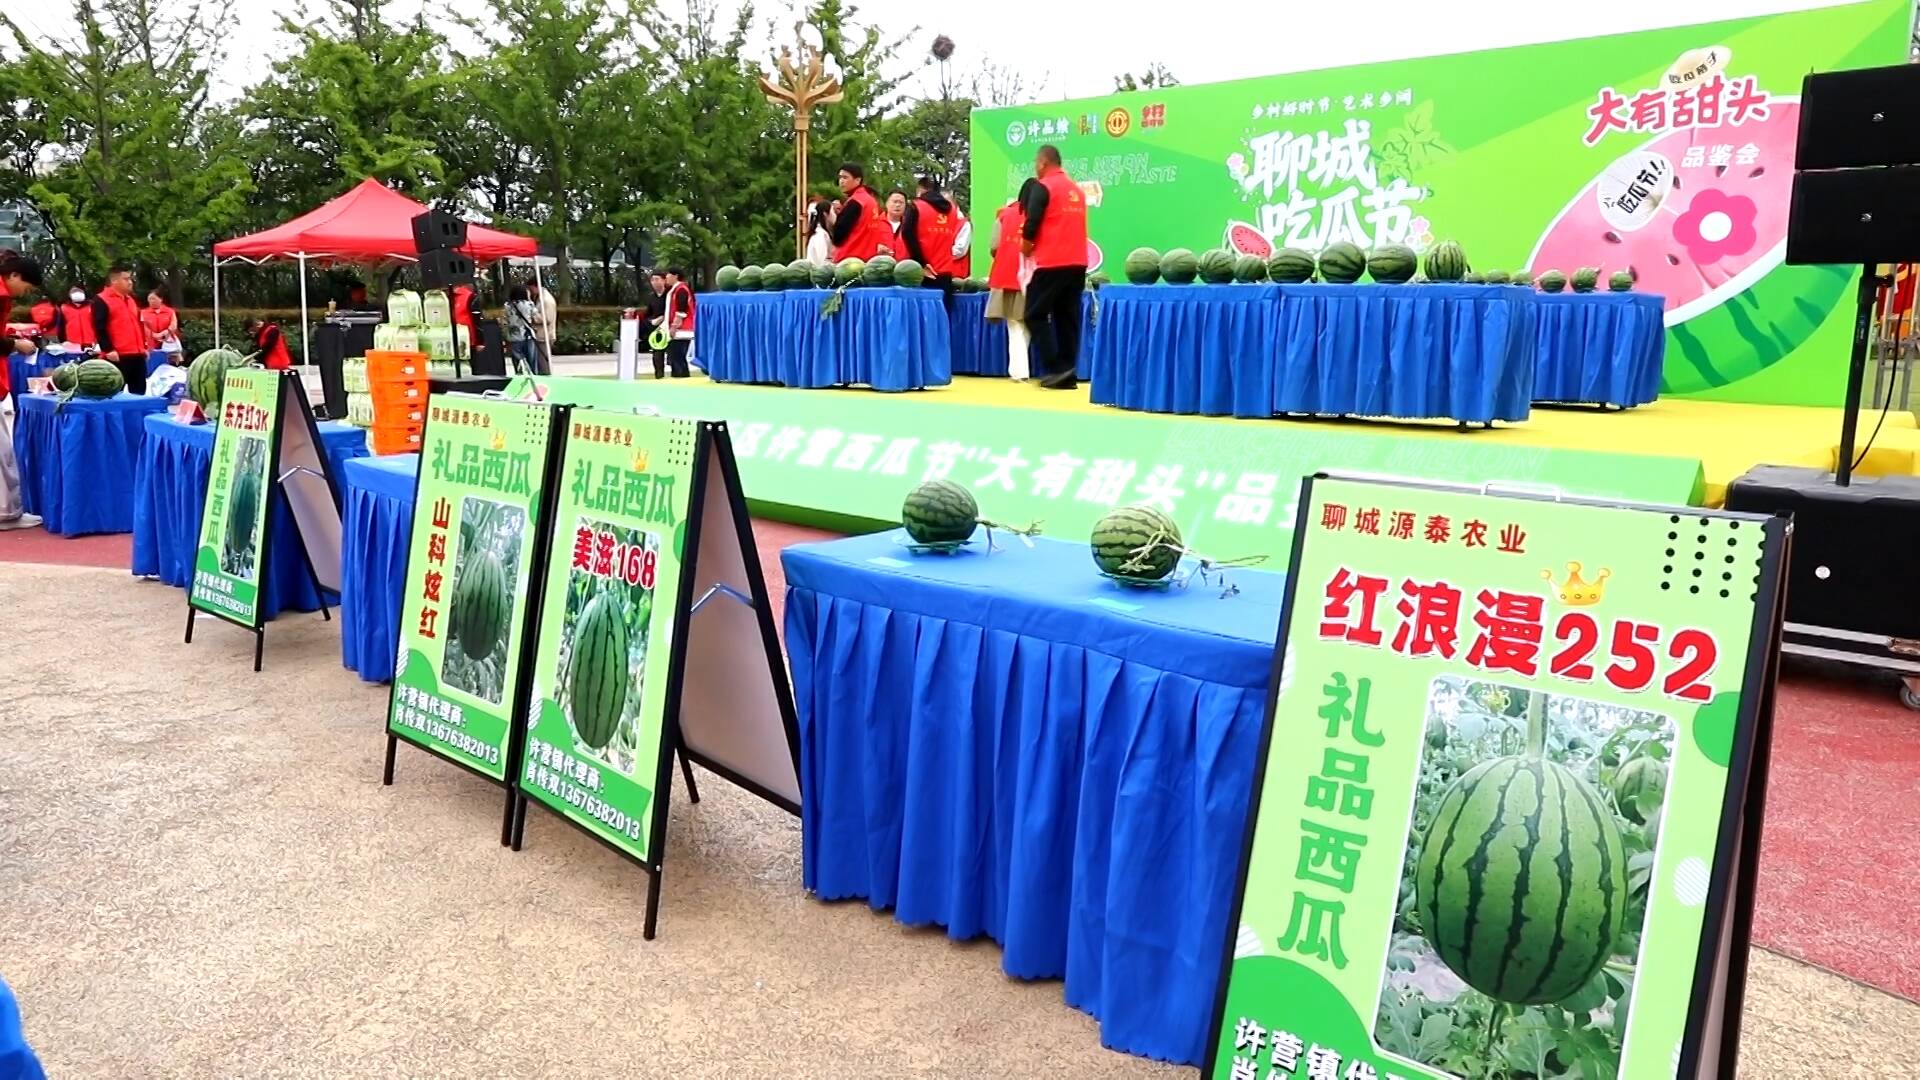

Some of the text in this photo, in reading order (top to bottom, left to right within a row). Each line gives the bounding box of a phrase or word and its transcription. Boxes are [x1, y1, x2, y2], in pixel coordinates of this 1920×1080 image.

[1585, 74, 1767, 144] 大有甜头
[1245, 118, 1378, 200] 聊城
[1680, 142, 1761, 168] 品鉴会
[1258, 177, 1424, 254] 吃瓜节
[223, 400, 270, 432] 东方红3K
[431, 437, 532, 498] 礼品西瓜
[571, 458, 676, 528] 礼品西瓜
[572, 525, 657, 590] 美滋168
[1320, 502, 1527, 555] 聊城源泰农业
[418, 496, 451, 640] 山科炫红
[1318, 567, 1719, 703] 红浪漫252
[1277, 671, 1386, 970] 礼品西瓜
